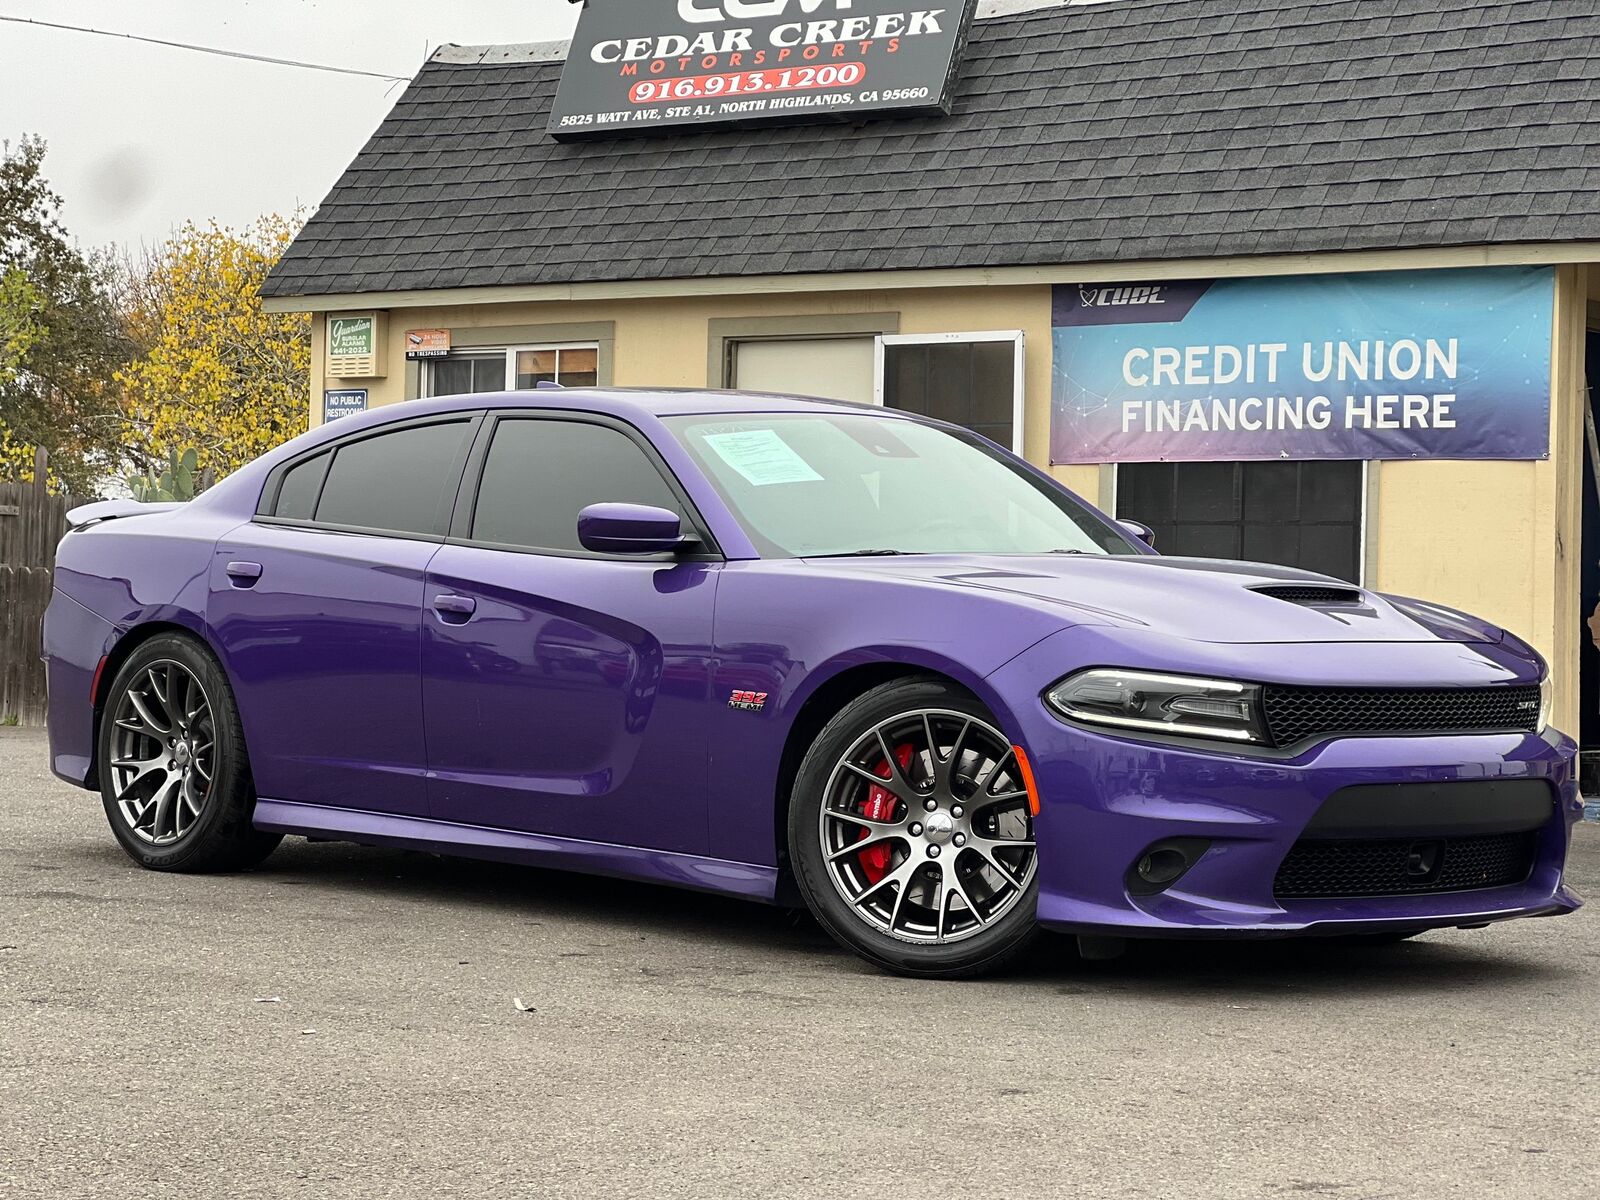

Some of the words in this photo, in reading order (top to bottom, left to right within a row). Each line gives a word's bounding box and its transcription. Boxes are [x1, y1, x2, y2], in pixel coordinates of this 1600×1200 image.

[590, 28, 753, 64] CEDAR
[769, 9, 946, 48] CREEK
[620, 38, 900, 76] MOTORSPORTS
[635, 64, 860, 101] 916.913.1200
[559, 114, 593, 126] 5825
[596, 111, 631, 124] WATT
[632, 108, 661, 120] AVE,
[665, 106, 691, 118] STE
[693, 104, 715, 116] A1,
[718, 99, 766, 114] NORTH
[768, 93, 855, 110] HIGHLANDS,
[859, 90, 879, 102] CA
[882, 86, 929, 101] 95660
[333, 346, 367, 354] 441-2022
[1122, 343, 1288, 387] CREDIT
[1302, 338, 1459, 383] UNION
[330, 396, 339, 405] NO
[340, 395, 362, 405] PUBLIC
[1121, 395, 1332, 433] FINANCING
[1344, 393, 1457, 430] HERE
[730, 689, 768, 704] 392
[872, 793, 882, 819] rembo
